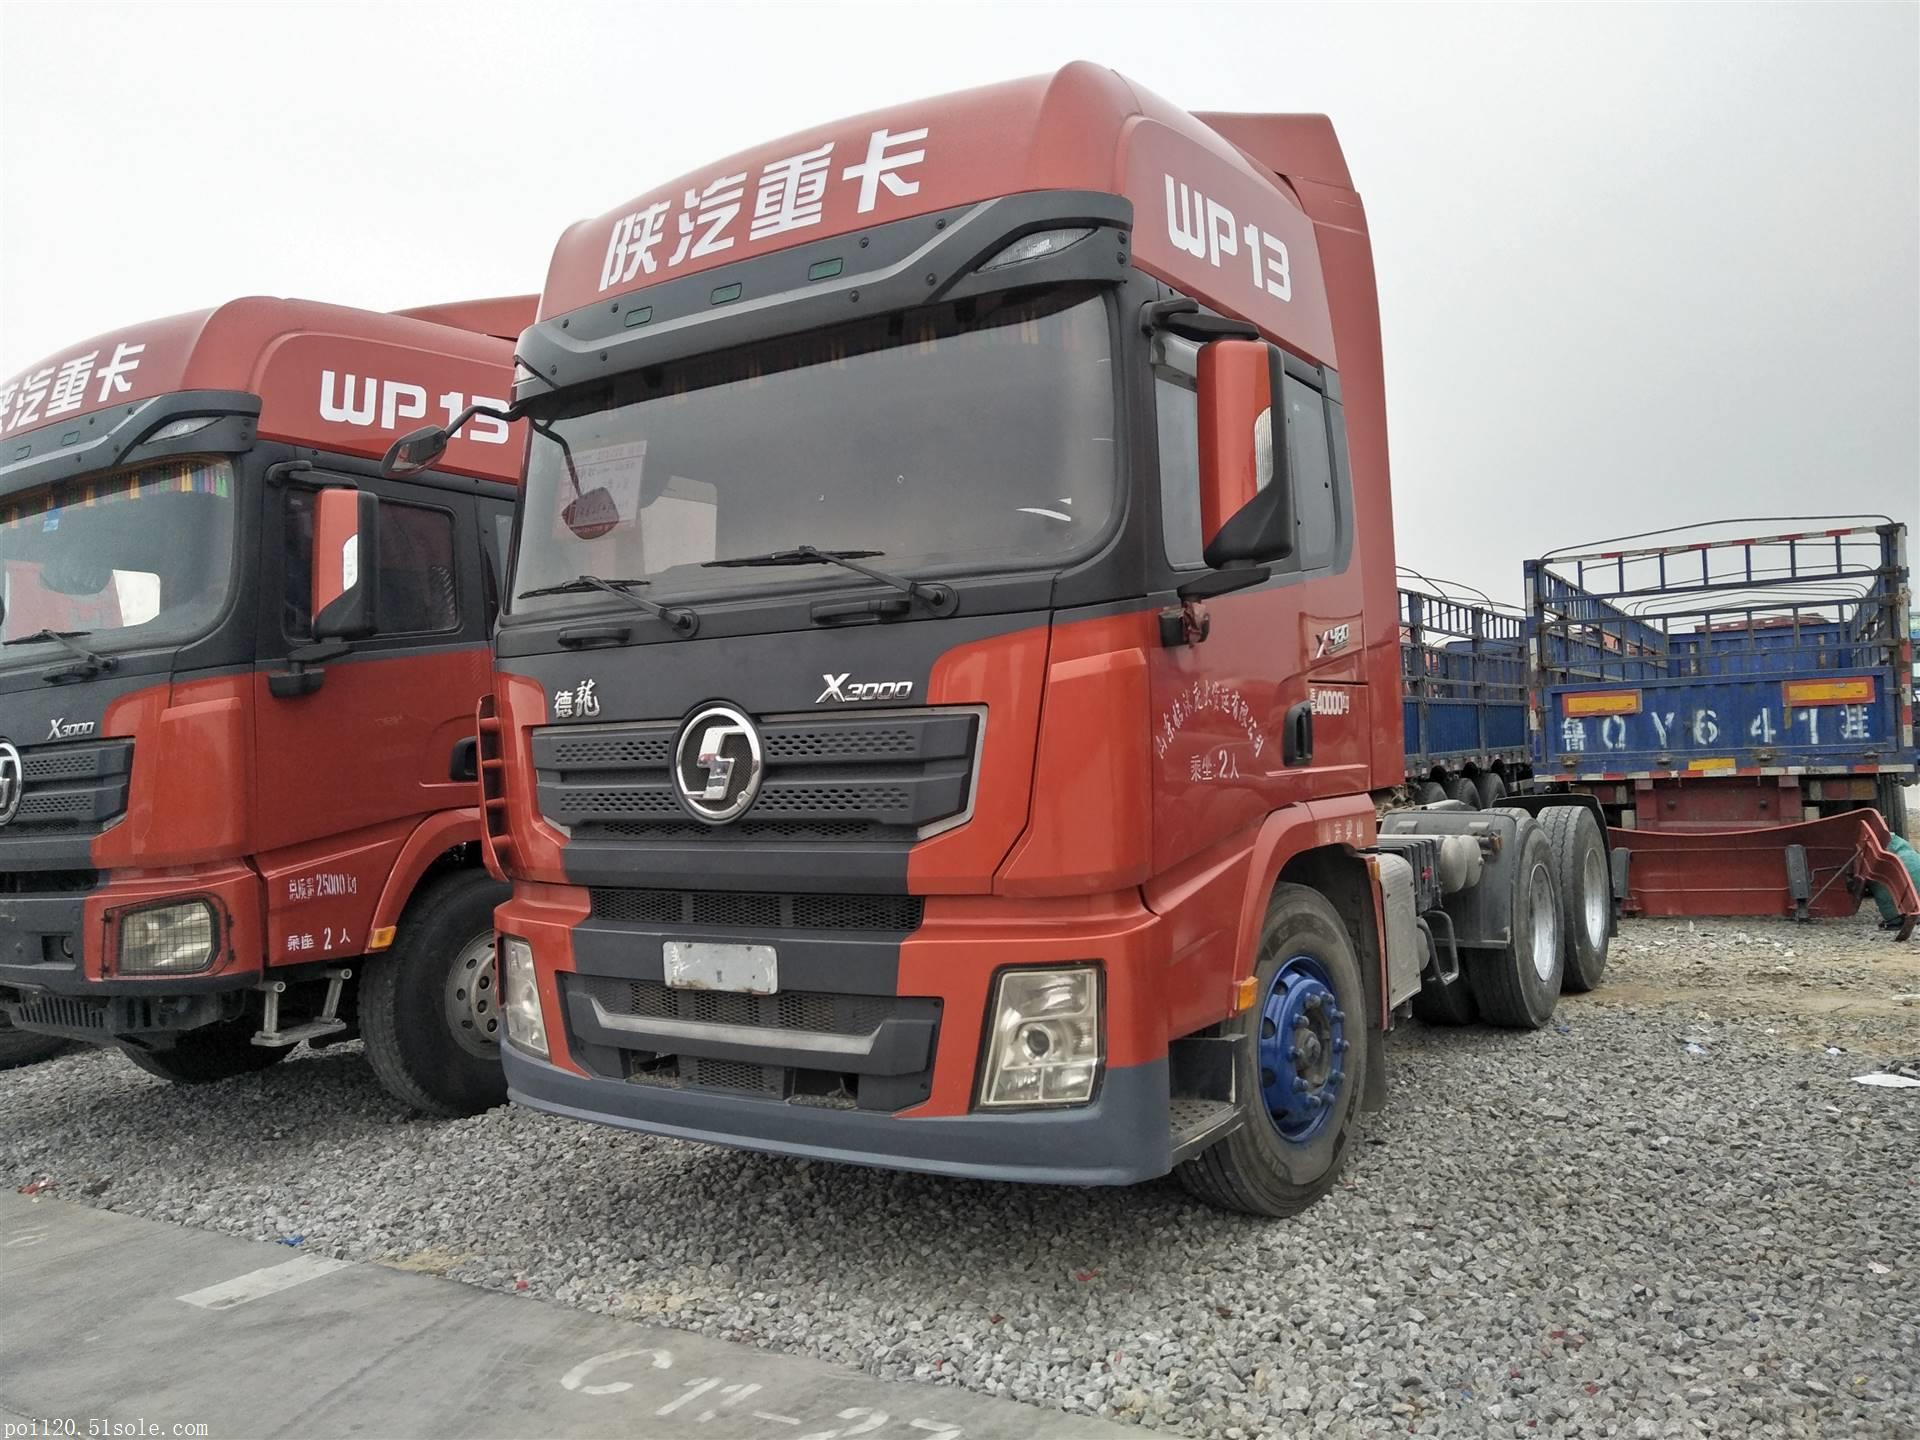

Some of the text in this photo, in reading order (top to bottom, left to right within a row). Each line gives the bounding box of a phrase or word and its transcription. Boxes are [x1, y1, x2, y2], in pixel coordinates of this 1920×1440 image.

[599, 126, 930, 291] 陕汽重卡
[1163, 173, 1293, 304] WP13
[319, 369, 510, 445] WP13
[815, 673, 913, 704] X3000
[47, 717, 95, 740] X3000
